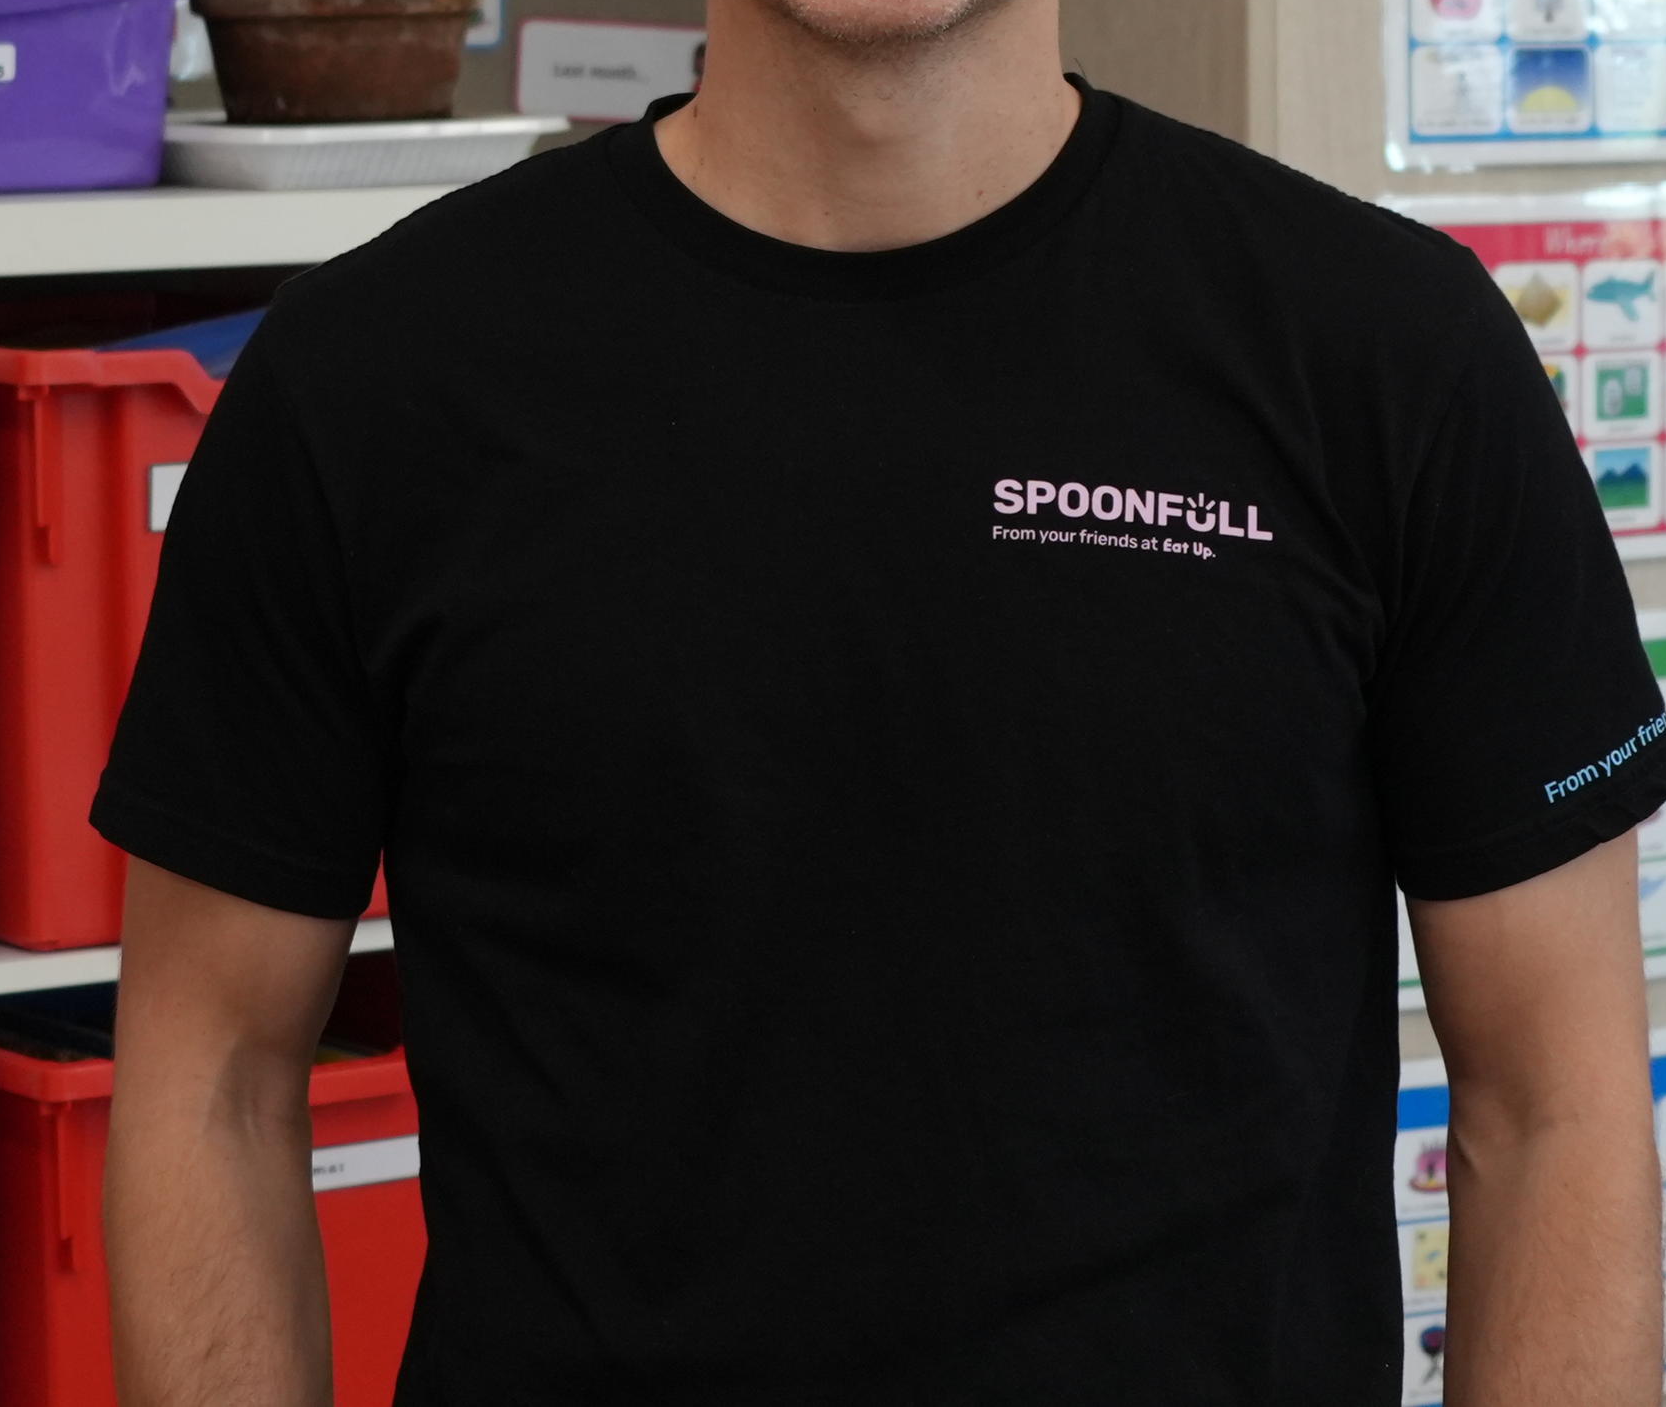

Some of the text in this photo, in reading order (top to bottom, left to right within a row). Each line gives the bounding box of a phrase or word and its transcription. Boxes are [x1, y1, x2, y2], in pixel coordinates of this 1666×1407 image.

[993, 478, 1274, 541] SPOONFULL
[992, 525, 1217, 560] From your friends at Eat Up.
[1543, 763, 1600, 804] From
[1597, 737, 1639, 778] your
